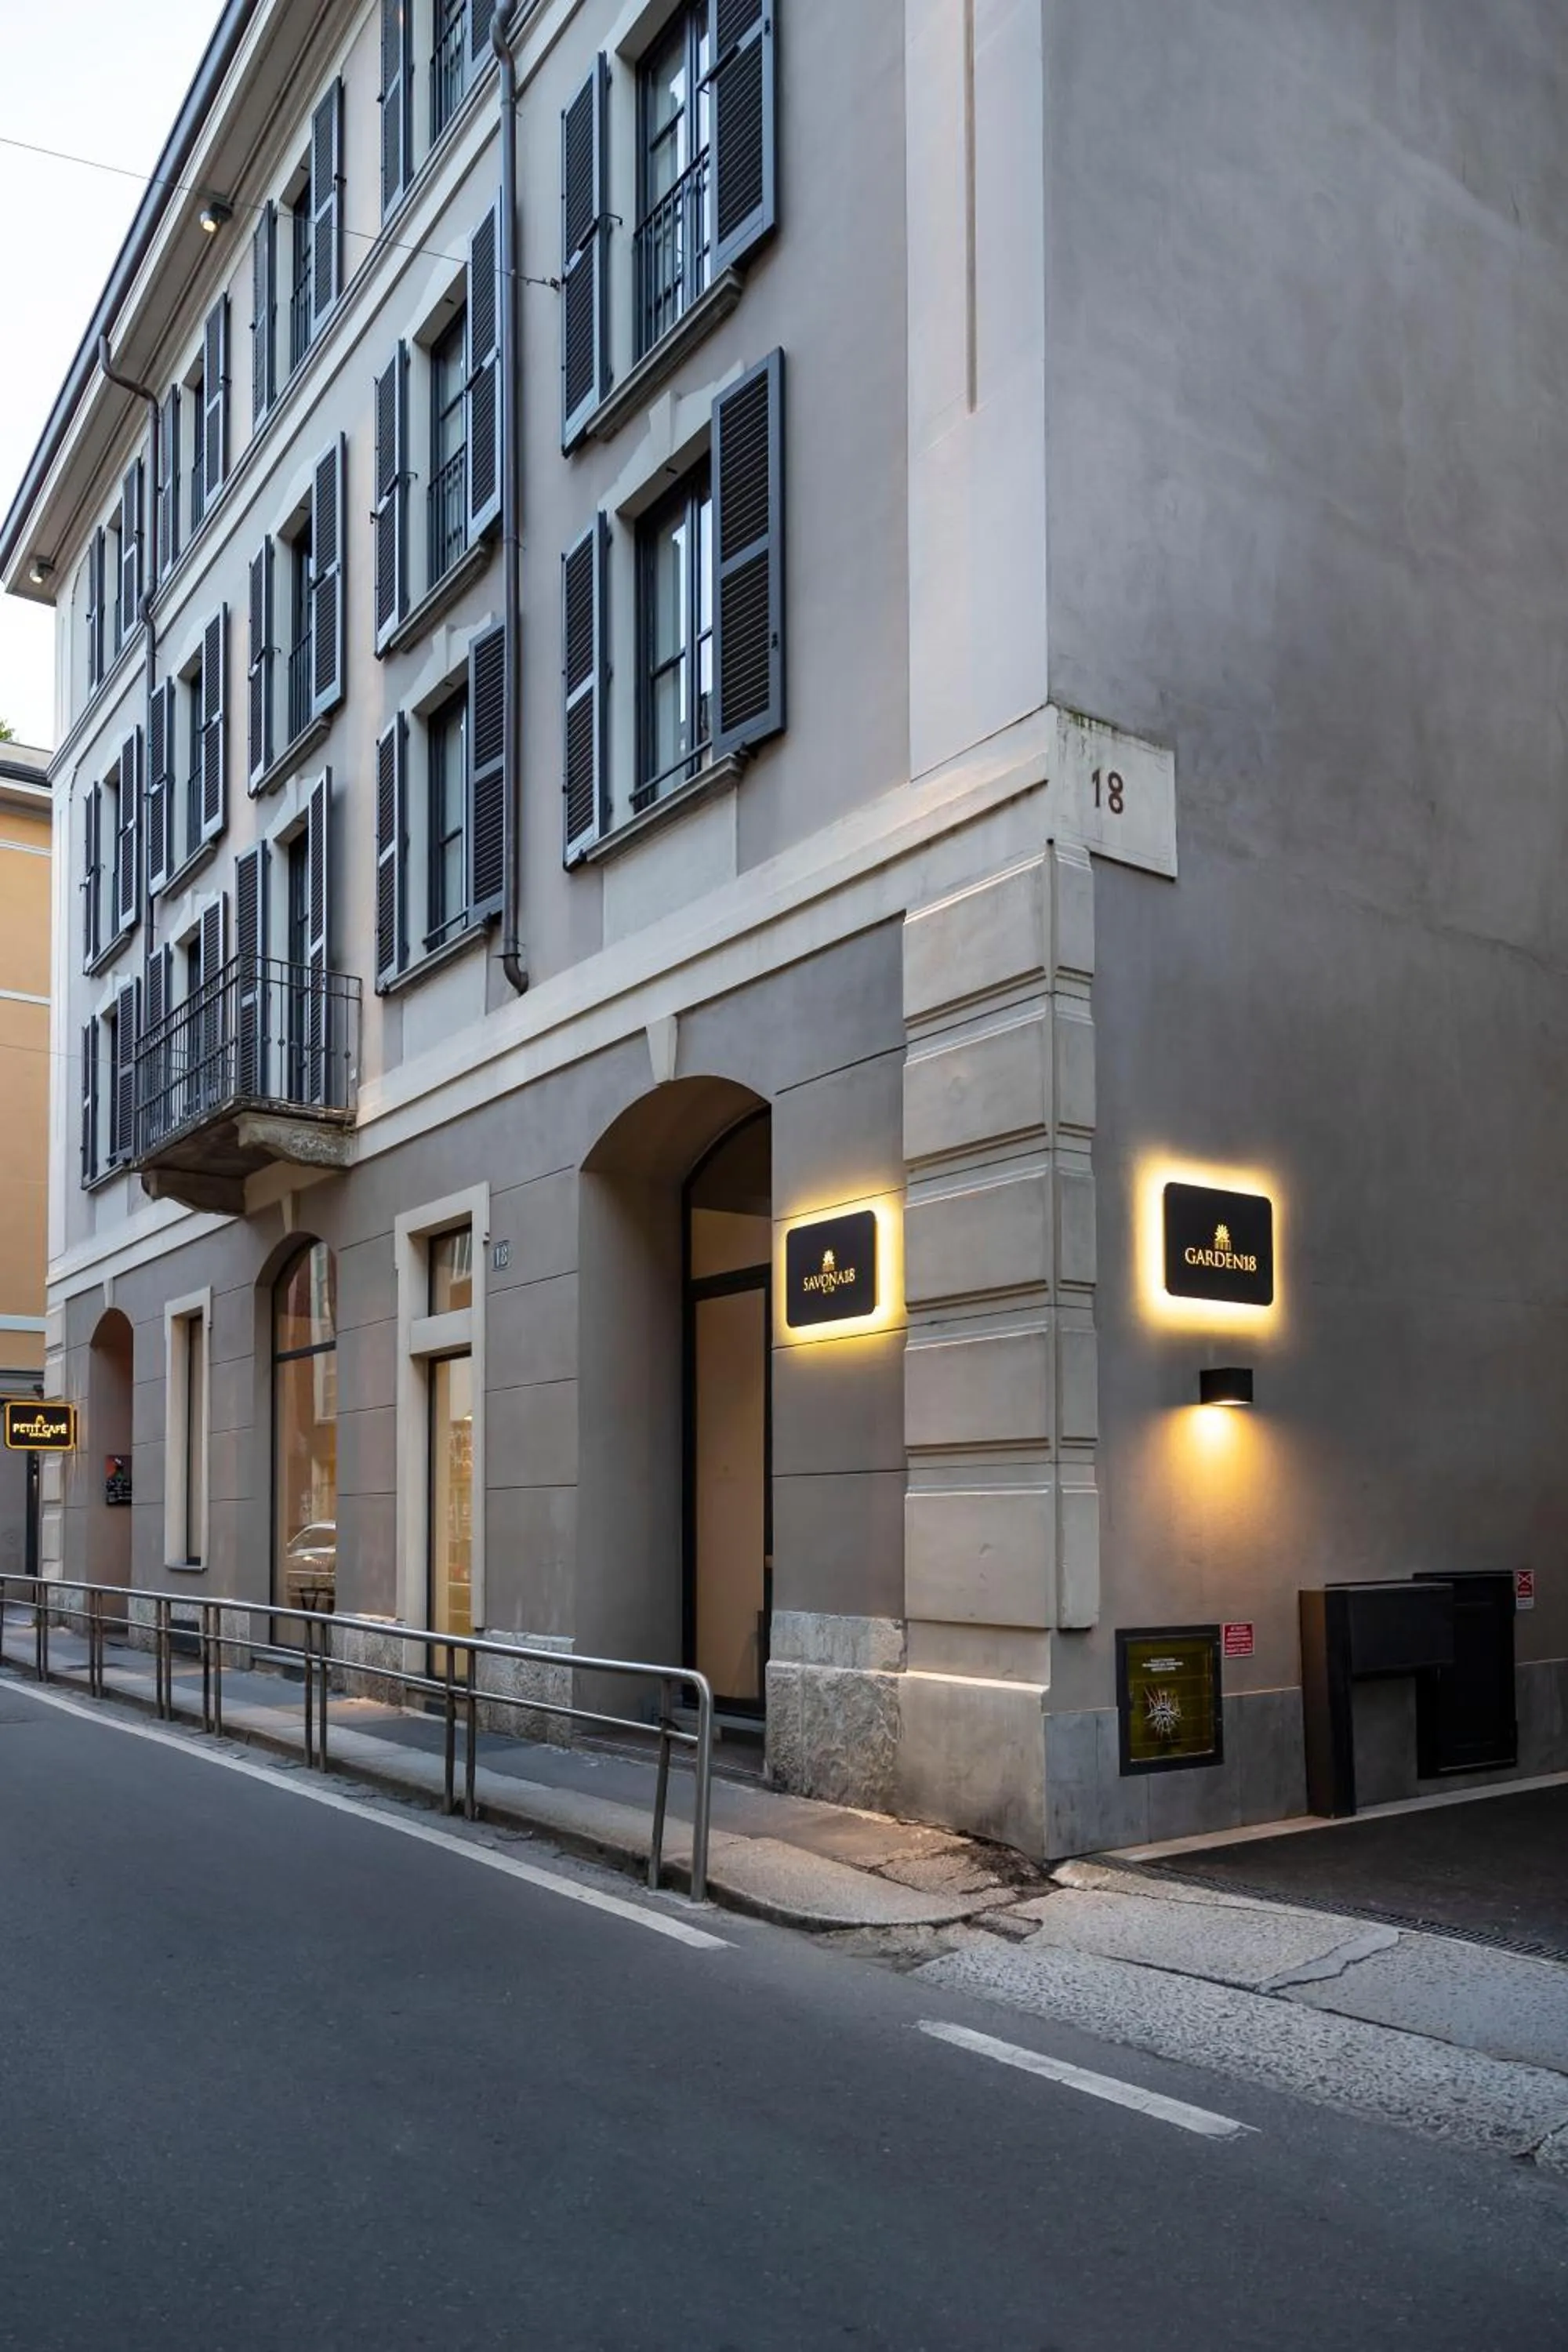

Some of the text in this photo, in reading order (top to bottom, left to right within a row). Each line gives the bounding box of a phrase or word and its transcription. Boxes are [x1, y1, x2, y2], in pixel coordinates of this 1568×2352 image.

[1091, 766, 1123, 815] 18
[495, 1243, 508, 1267] 18
[1185, 1247, 1257, 1272] GARDEN18
[803, 1268, 855, 1291] SAVONA18
[13, 1423, 41, 1433] PETIT
